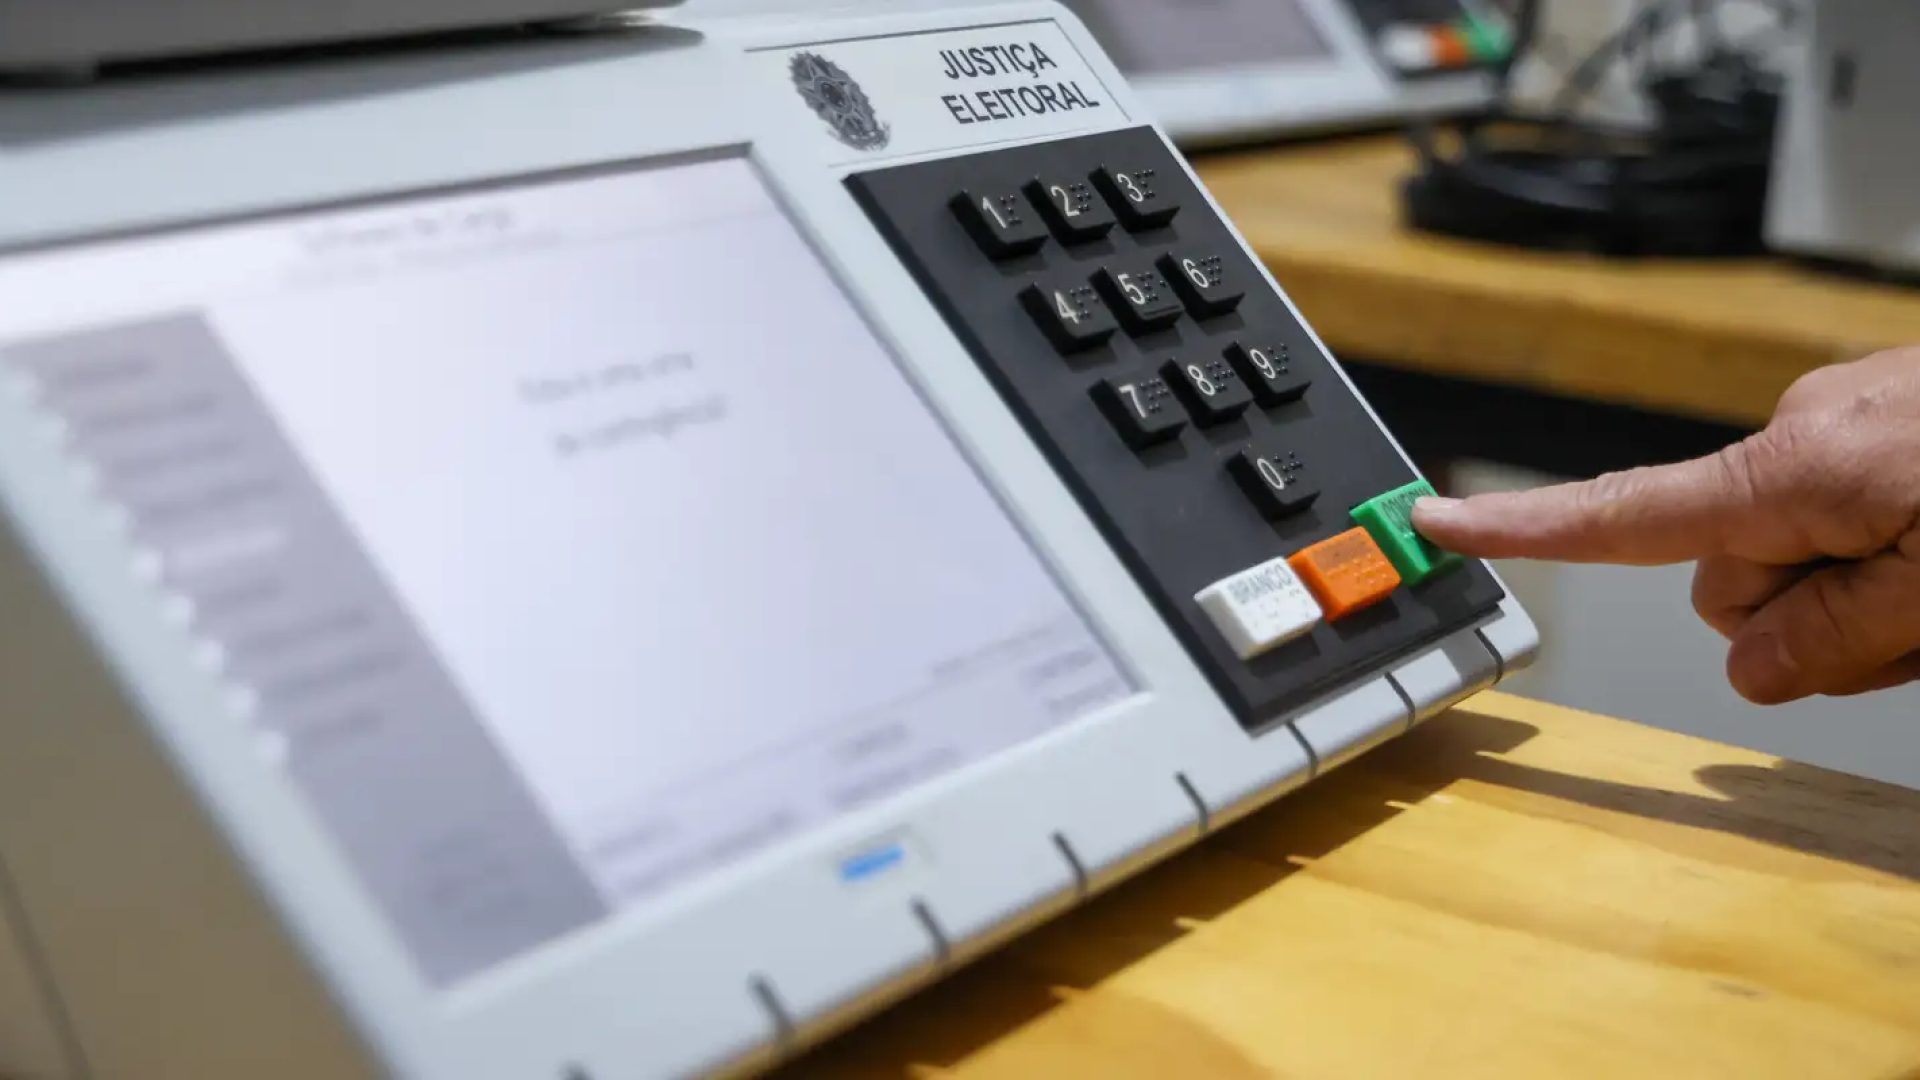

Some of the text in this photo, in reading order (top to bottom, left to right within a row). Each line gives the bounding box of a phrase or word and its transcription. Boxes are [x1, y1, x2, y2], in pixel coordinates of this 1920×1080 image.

[939, 42, 1057, 78] JUSTIÇA
[941, 81, 1100, 125] ELEITORAL
[1051, 185, 1080, 217] 2
[1117, 173, 1144, 202] 3
[982, 197, 1006, 229] 1
[1182, 258, 1209, 288] 6
[1117, 274, 1146, 305] 5
[1054, 291, 1079, 324] 4
[1187, 364, 1216, 396] 8
[1249, 349, 1276, 379] 9
[1119, 384, 1147, 418] 7
[1256, 458, 1284, 490] 0
